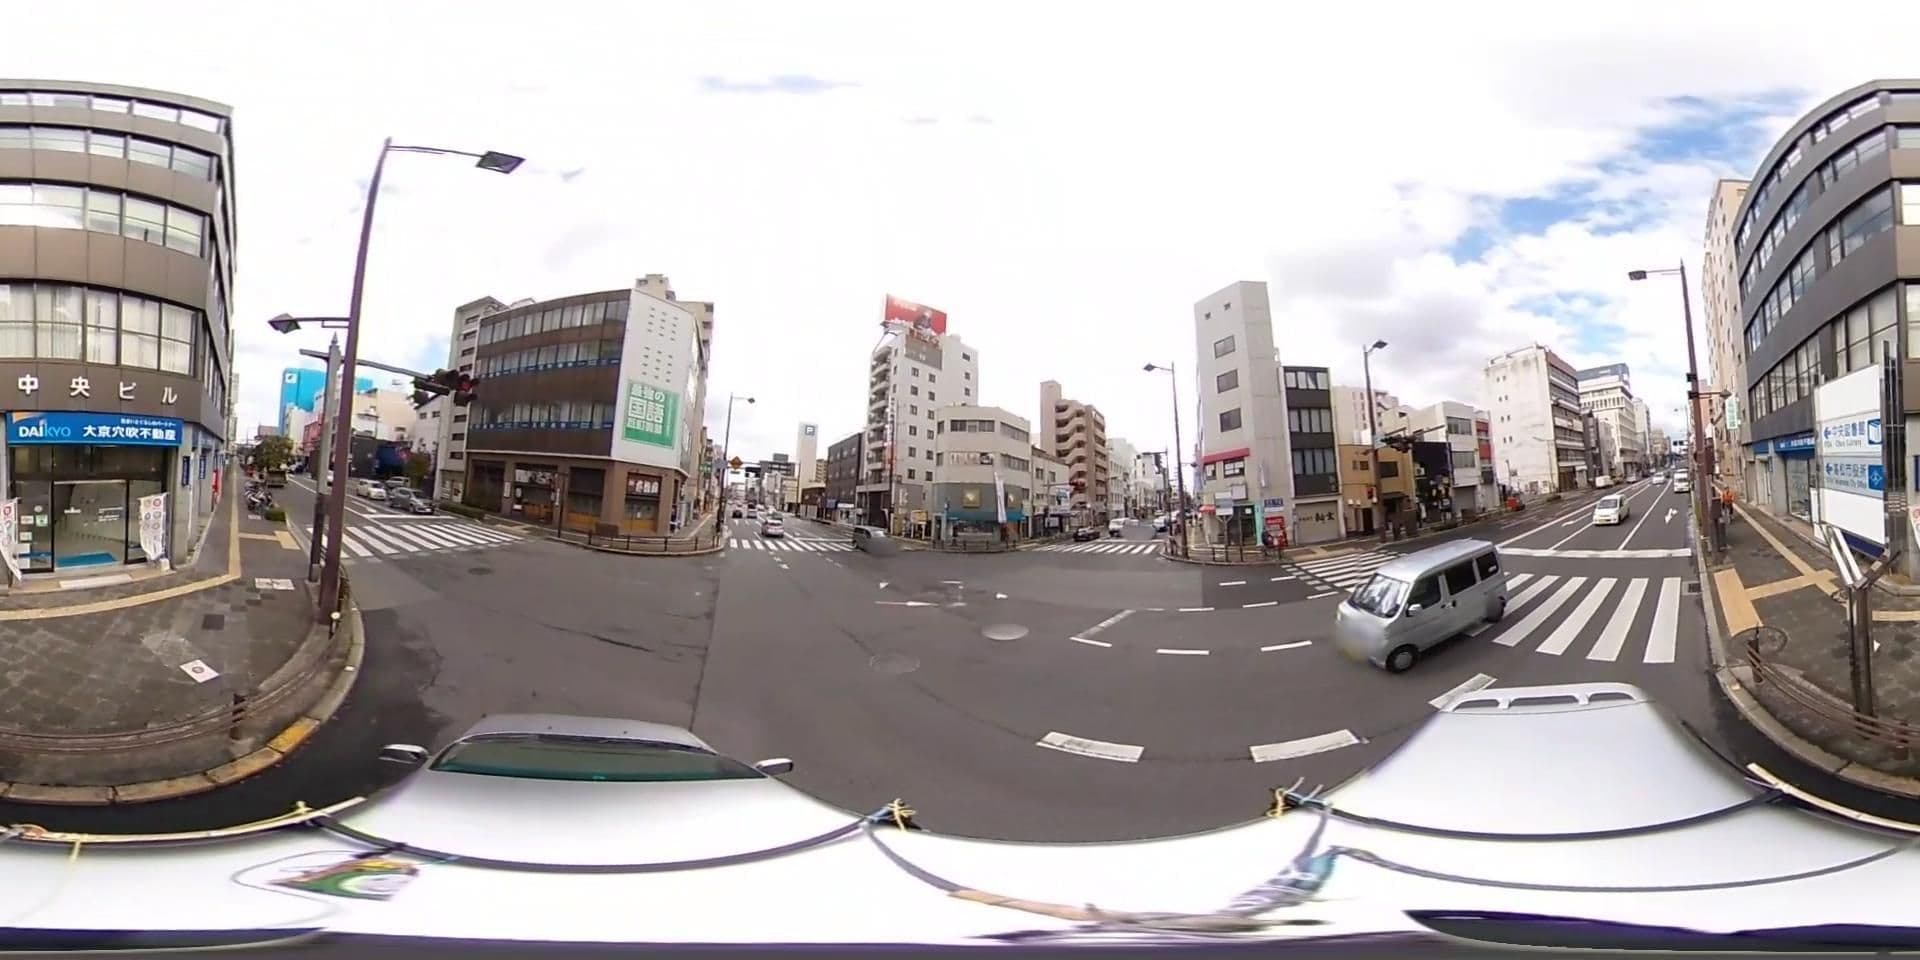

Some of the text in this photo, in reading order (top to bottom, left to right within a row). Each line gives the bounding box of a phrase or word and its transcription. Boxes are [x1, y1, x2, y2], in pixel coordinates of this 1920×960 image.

[18, 374, 178, 404] 中央ビル
[82, 425, 176, 441] 大京穴吹不動産
[1832, 421, 1865, 437] 中央図書館
[1833, 463, 1866, 477] 高松市役所
